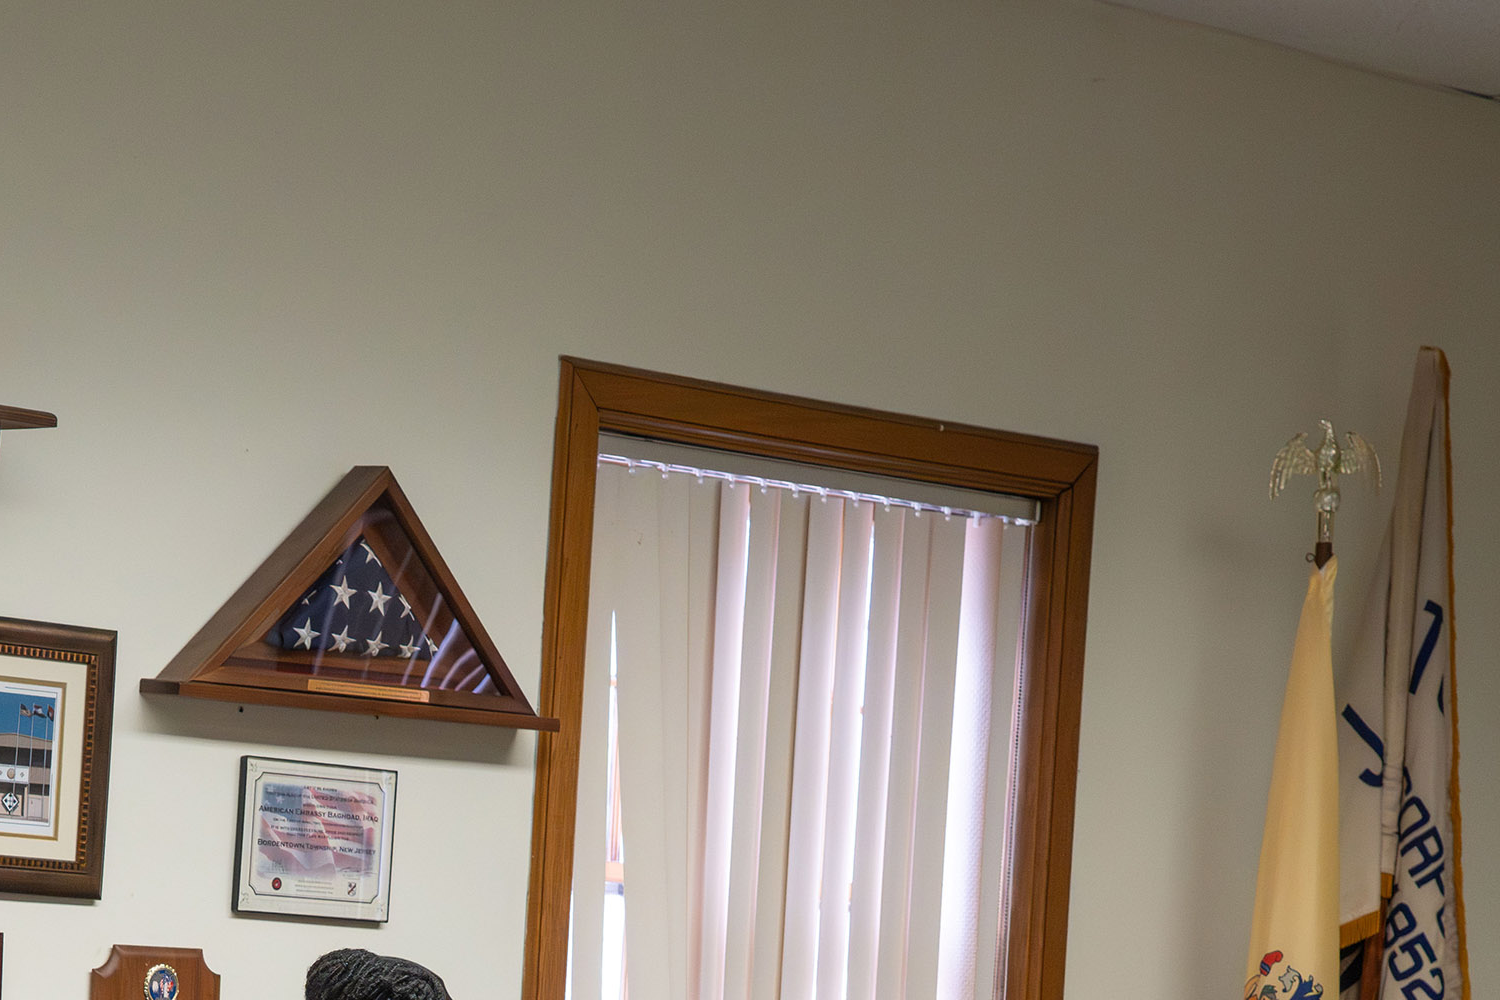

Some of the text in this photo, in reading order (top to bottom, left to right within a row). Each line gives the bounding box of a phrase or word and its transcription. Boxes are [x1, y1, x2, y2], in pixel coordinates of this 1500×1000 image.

[259, 806, 294, 815] AMERICAN
[295, 808, 326, 818] EMBASSY
[328, 812, 362, 821] BAGHDAD,
[258, 838, 305, 849] BORDENTOWN
